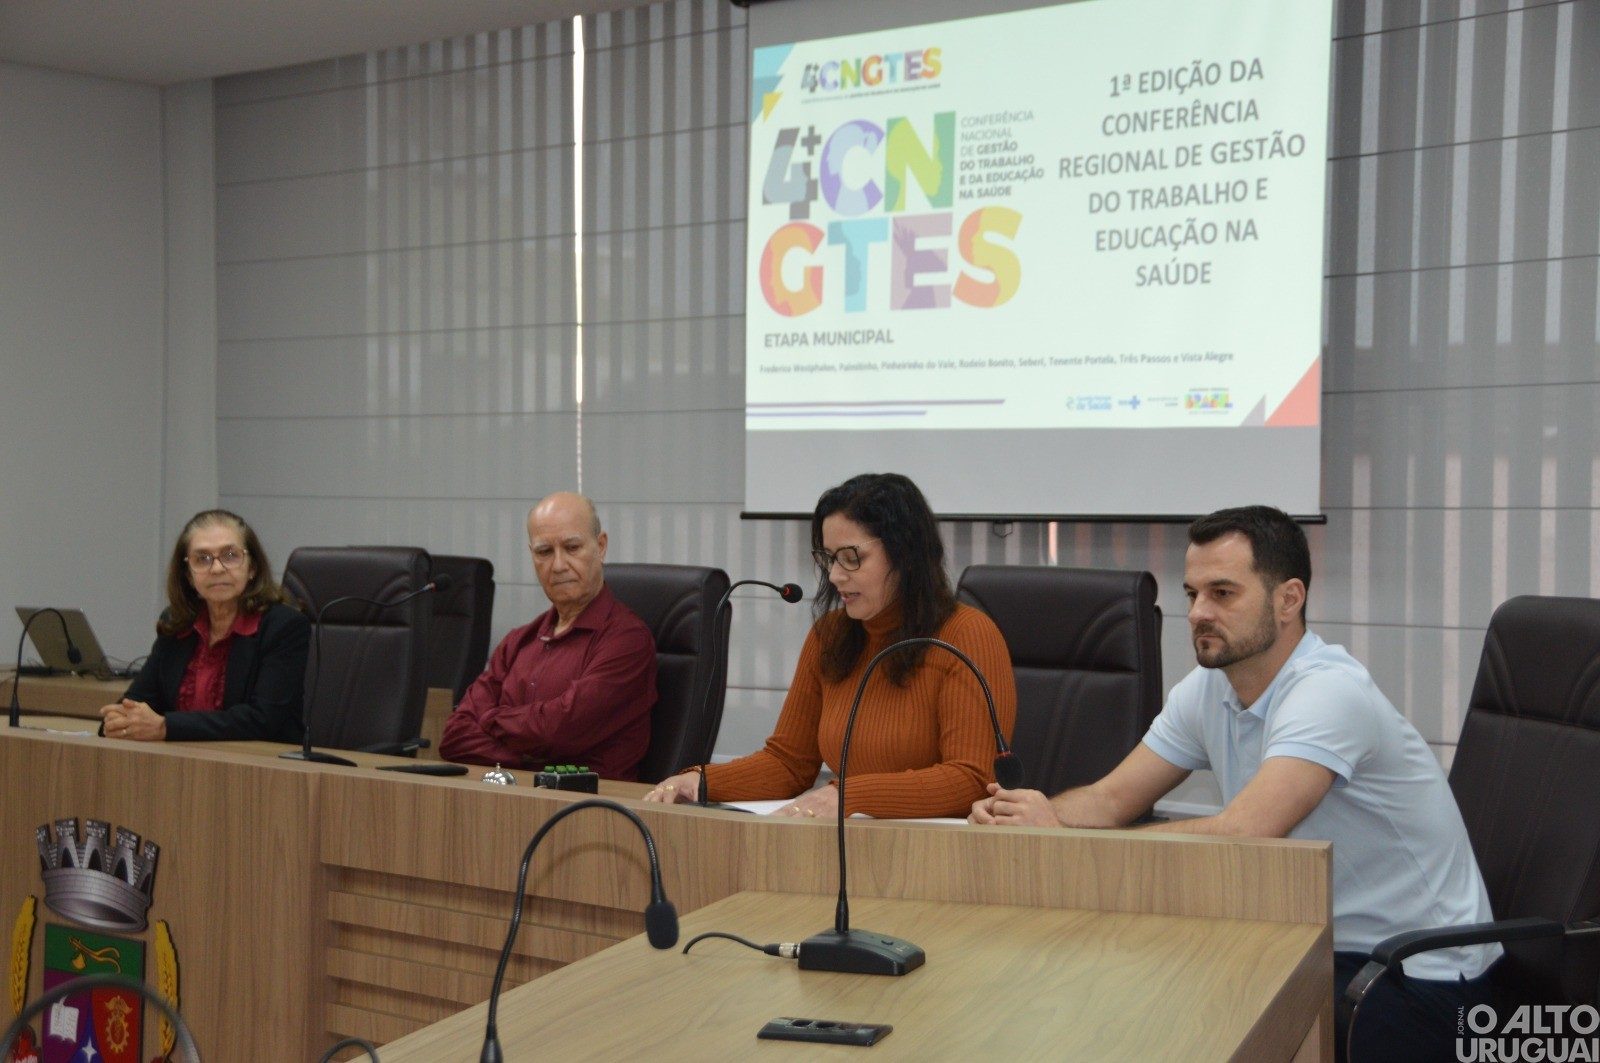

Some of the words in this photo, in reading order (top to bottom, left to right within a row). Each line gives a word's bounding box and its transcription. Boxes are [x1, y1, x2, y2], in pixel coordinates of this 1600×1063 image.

[1109, 73, 1132, 98] 1ª
[1137, 59, 1222, 95] EDIÇÃO
[1230, 57, 1265, 83] DA
[960, 110, 1035, 128] CONFERÊNCIA
[1101, 98, 1260, 137] CONFERÊNCIA
[960, 127, 1014, 143] NACIONAL
[960, 145, 975, 157] DE
[976, 139, 1019, 155] GESTÃO
[959, 160, 976, 172] DO
[979, 154, 1035, 170] TRABALHO
[1058, 147, 1169, 179] REGIONAL
[1174, 144, 1203, 169] DE
[1210, 129, 1307, 166] GESTÃO
[959, 175, 967, 186] E
[968, 173, 983, 184] DA
[986, 166, 1046, 184] EDUCAÇÃO
[959, 188, 974, 199] NA
[976, 184, 1013, 198] SAÚDE
[1088, 190, 1121, 214] DO
[1127, 179, 1249, 212] TRABALHO
[1255, 177, 1269, 201] E
[1095, 216, 1219, 252] EDUCAÇÃO
[1225, 218, 1260, 243] NA
[759, 205, 1024, 318] GTES
[1134, 256, 1213, 288] SAÚDE
[763, 331, 810, 349] ETAPA
[812, 328, 895, 347] MUNICIPAL
